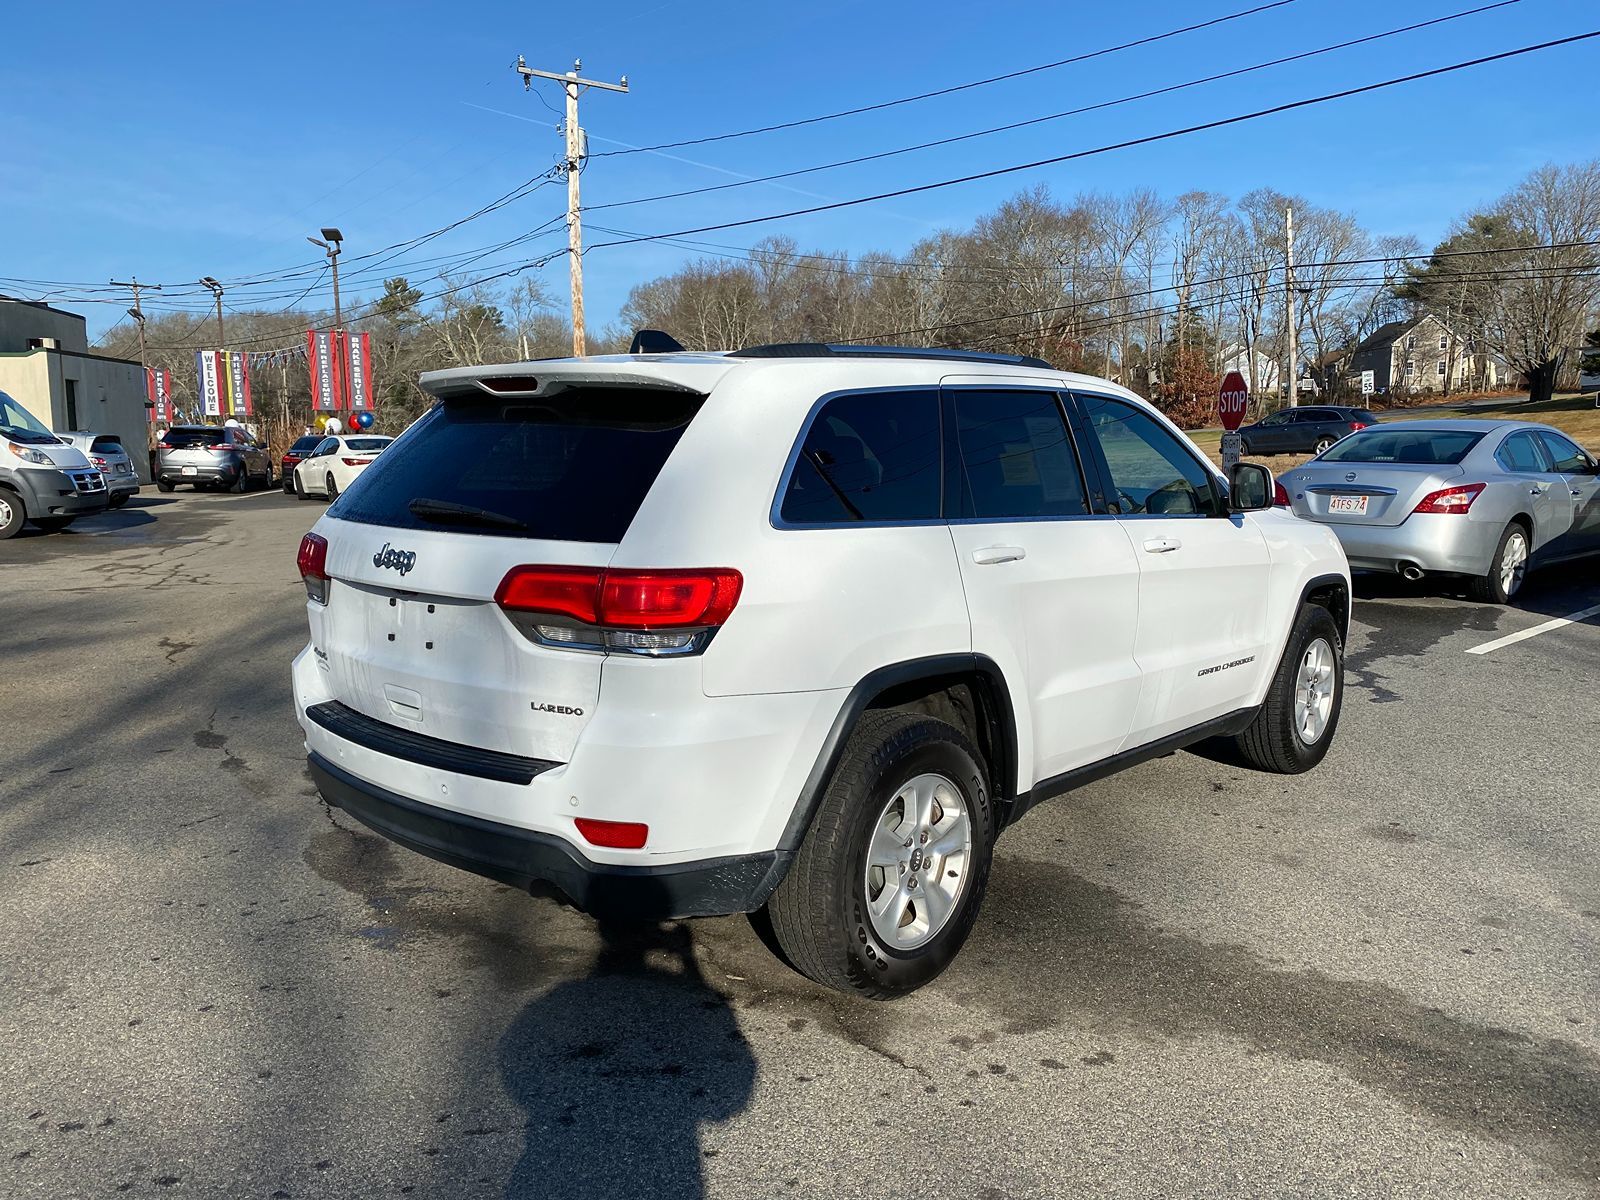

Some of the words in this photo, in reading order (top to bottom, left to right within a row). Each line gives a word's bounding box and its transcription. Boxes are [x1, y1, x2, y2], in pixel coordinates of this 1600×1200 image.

[319, 335, 327, 354] TIRE
[351, 337, 361, 366] BRAKE
[204, 355, 217, 412] WELCOME
[233, 355, 243, 405] PRESTIGE
[321, 355, 331, 406] REPLACEMENT
[353, 366, 363, 406] SERVICE
[1363, 382, 1373, 391] 55
[1220, 391, 1245, 413] STOP
[1224, 438, 1239, 448] RIGHT
[1354, 500, 1365, 511] 74
[373, 542, 416, 576] Jeep
[1197, 665, 1222, 677] GRAND
[1222, 655, 1256, 670] CHEROKEE
[530, 701, 584, 716] LAREDO
